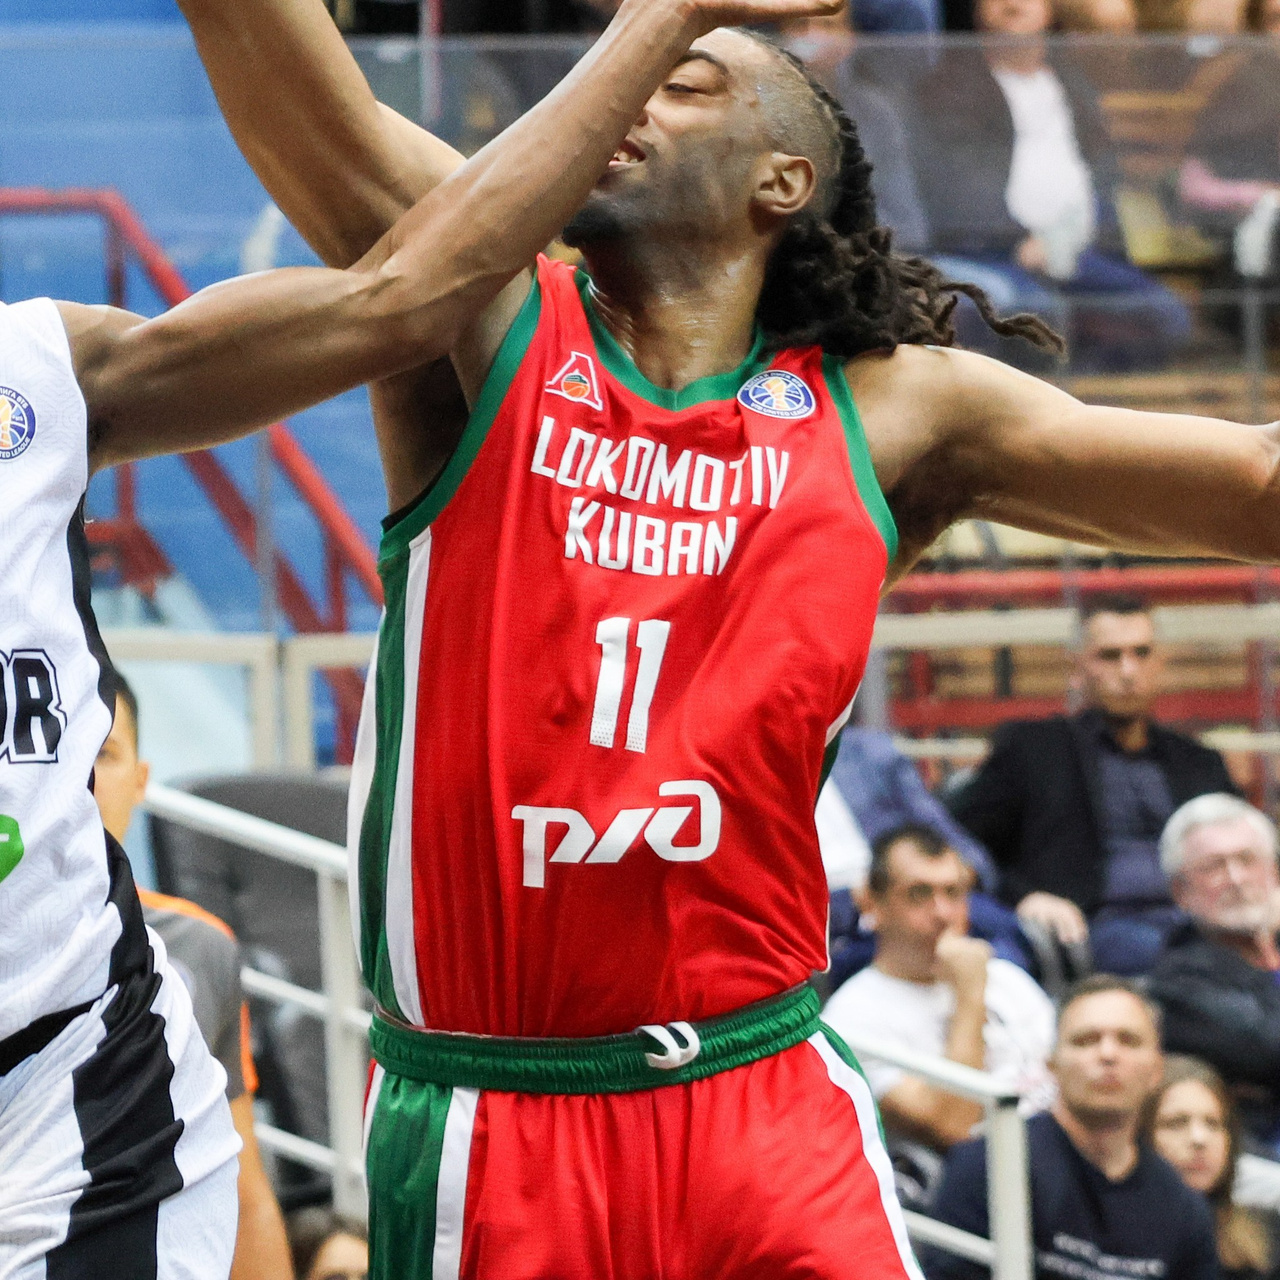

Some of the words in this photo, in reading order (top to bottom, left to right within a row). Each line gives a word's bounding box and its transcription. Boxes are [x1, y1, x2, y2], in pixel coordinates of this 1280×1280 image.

[530, 415, 790, 511] LOKOMOTIV
[564, 496, 738, 576] KUBAN
[589, 616, 671, 754] 11
